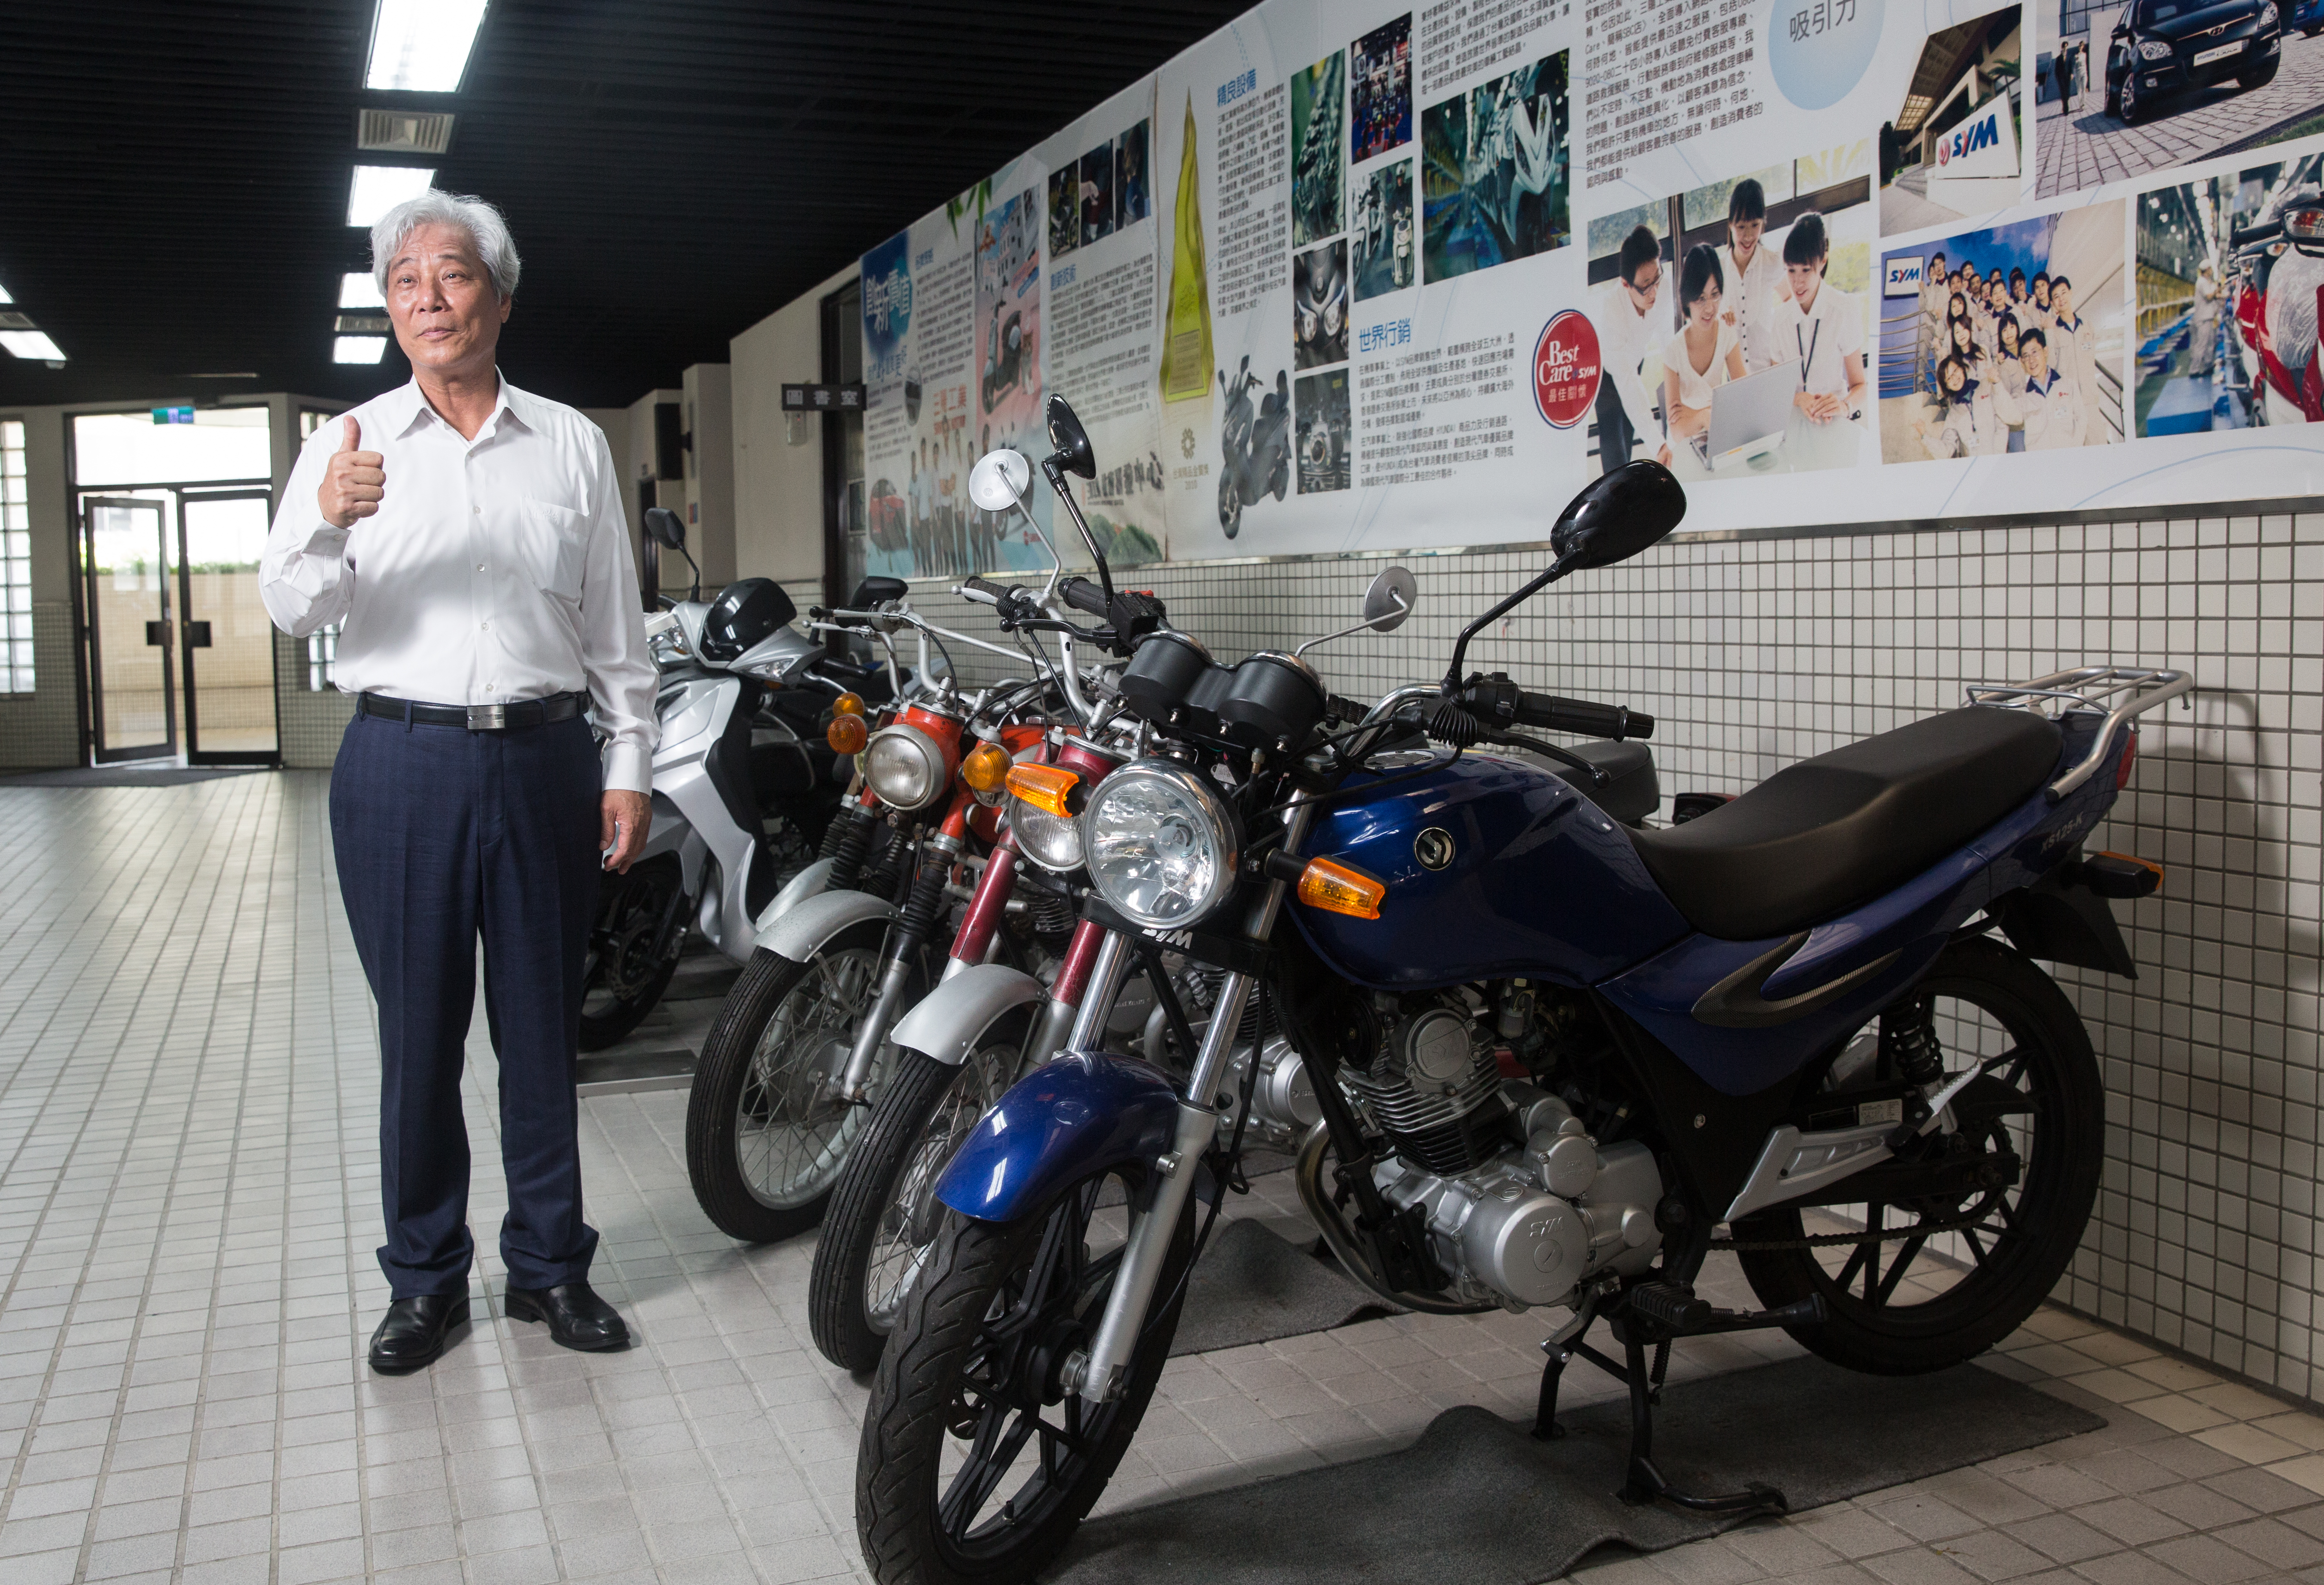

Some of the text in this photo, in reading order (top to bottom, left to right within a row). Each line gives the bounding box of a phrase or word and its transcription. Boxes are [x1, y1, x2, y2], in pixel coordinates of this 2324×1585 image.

[1789, 0, 1855, 43] 吸引力
[1217, 68, 1257, 108] 精良設備
[1952, 113, 1999, 158] SYM
[1889, 268, 1920, 283] SYM
[1359, 318, 1411, 353] 世界行銷
[1549, 340, 1580, 366] Best
[1539, 360, 1597, 385] Care SYM
[1549, 384, 1586, 403] 最佳關懷
[2040, 811, 2084, 854] XS125-K
[1530, 1216, 1564, 1238] SYM
